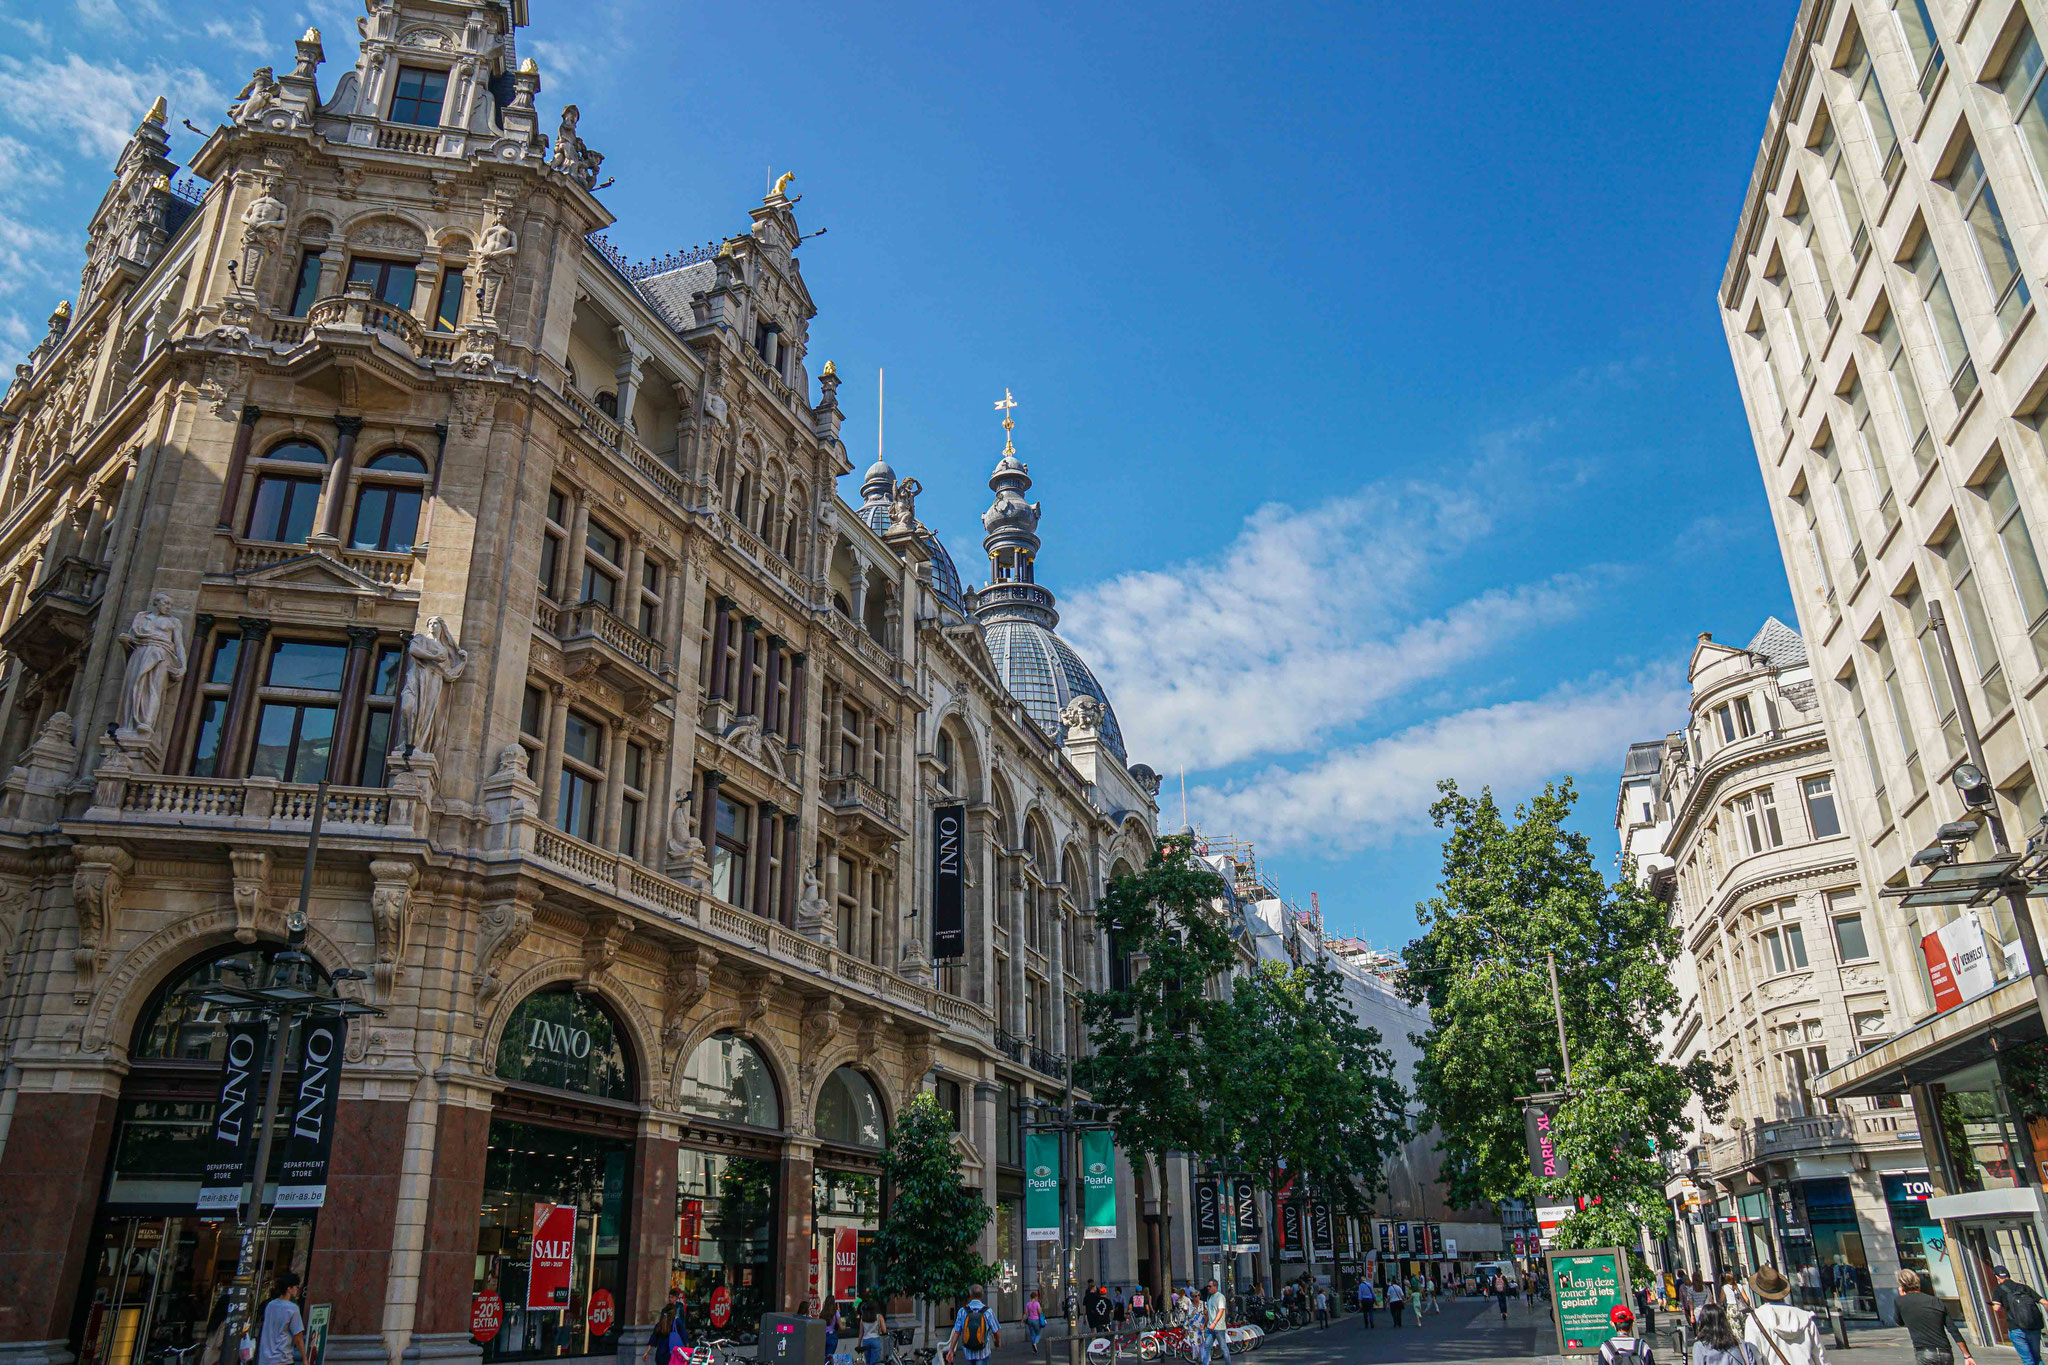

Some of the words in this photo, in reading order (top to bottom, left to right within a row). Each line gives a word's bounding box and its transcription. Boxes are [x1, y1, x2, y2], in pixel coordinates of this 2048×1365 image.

[940, 816, 958, 876] INNO
[1960, 946, 1983, 966] VERHELST
[528, 1019, 591, 1058] INNO
[216, 1034, 254, 1146] INNO
[294, 1028, 334, 1144] INNO
[1537, 1113, 1550, 1131] XL
[1540, 1136, 1556, 1176] PARIS
[284, 1160, 325, 1168] DEPARTMENT
[1028, 1178, 1057, 1187] Pearle
[1084, 1176, 1112, 1184] Pearle
[200, 1192, 239, 1202] meir-as.be
[278, 1190, 322, 1201] meir-as.be
[1200, 1187, 1214, 1230] INNO
[1239, 1185, 1253, 1229] INNO
[1286, 1207, 1298, 1239] INNO
[1316, 1205, 1327, 1238] INNO
[1382, 1226, 1387, 1234] P
[1400, 1225, 1405, 1233] P
[535, 1240, 570, 1259] SALE
[836, 1252, 855, 1265] SALE
[1595, 1277, 1614, 1286] deze
[1560, 1290, 1587, 1298] zomer
[1590, 1288, 1597, 1296] al
[1599, 1287, 1614, 1295] iets
[474, 1303, 499, 1317] -20%
[711, 1303, 730, 1317] -50%
[1562, 1297, 1598, 1309] geplant?
[588, 1308, 612, 1323] -50%
[473, 1318, 498, 1328] EXTRA
